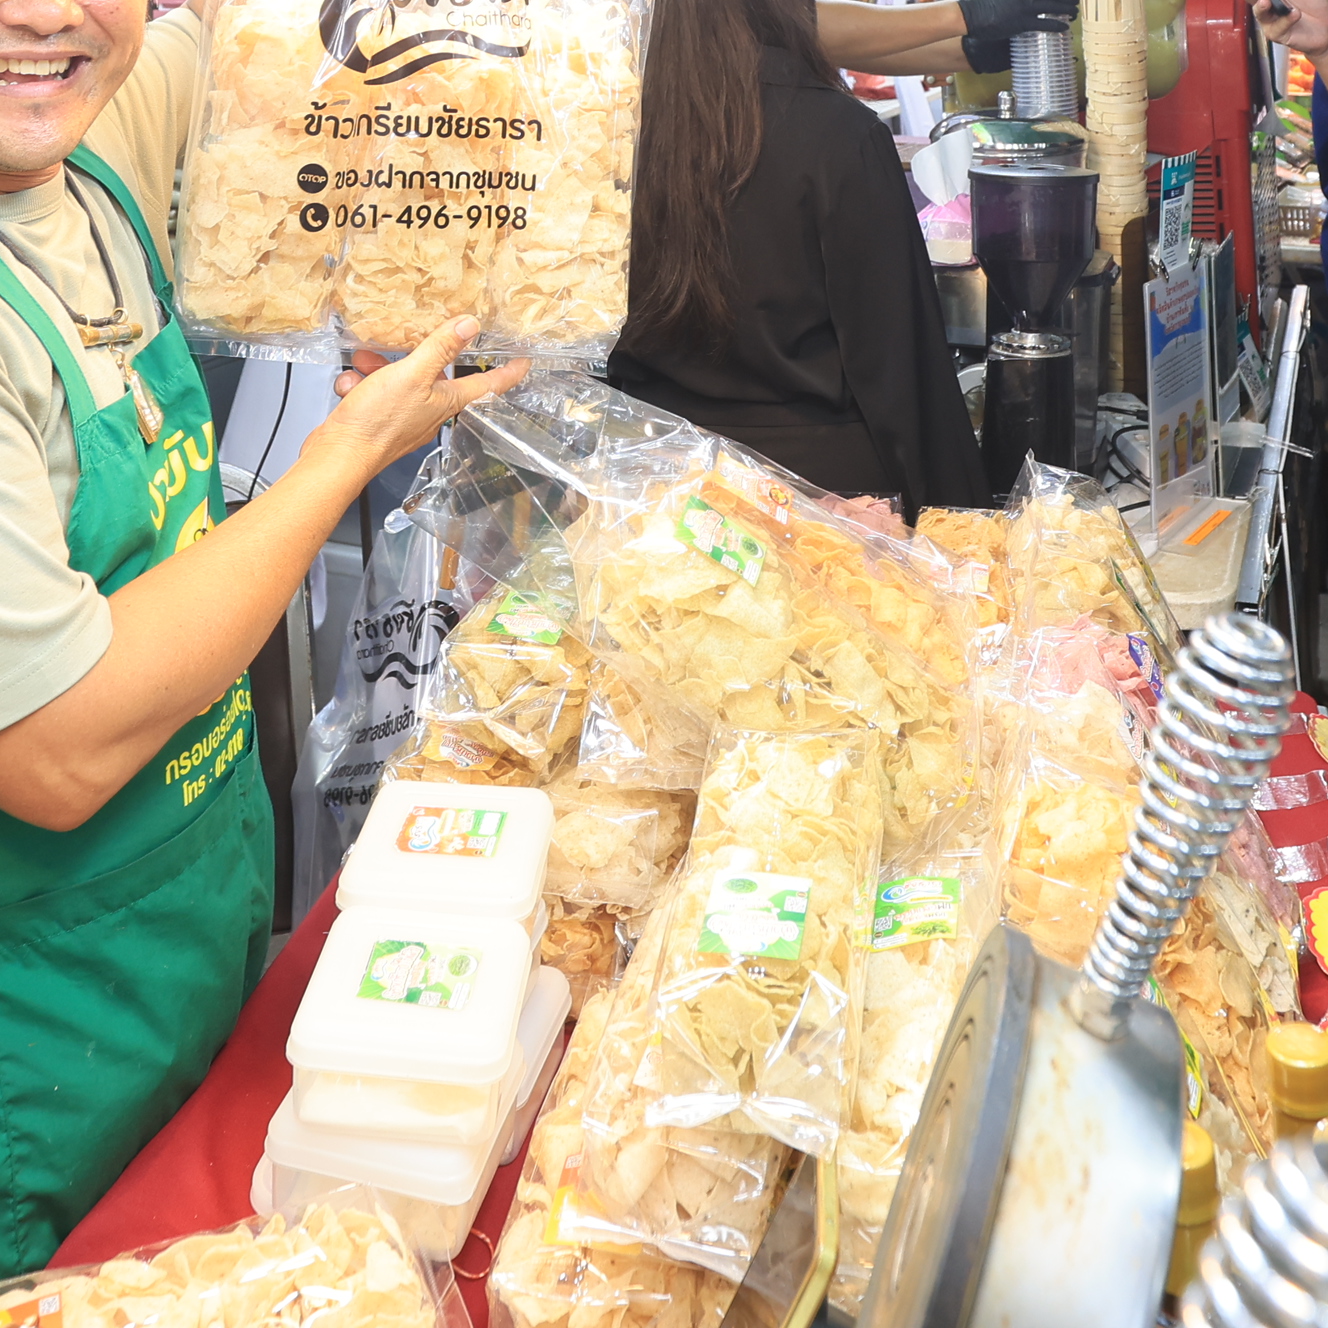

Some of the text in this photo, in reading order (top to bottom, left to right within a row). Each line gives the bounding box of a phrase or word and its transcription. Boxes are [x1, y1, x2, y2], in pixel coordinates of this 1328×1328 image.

[446, 10, 532, 30] Chaithara
[303, 101, 543, 142] ข้าวเกรียบชัยธารา
[335, 163, 537, 198] ของฝากจากชุมชน
[335, 204, 528, 230] 061-496-9198
[182, 774, 206, 807] โทร
